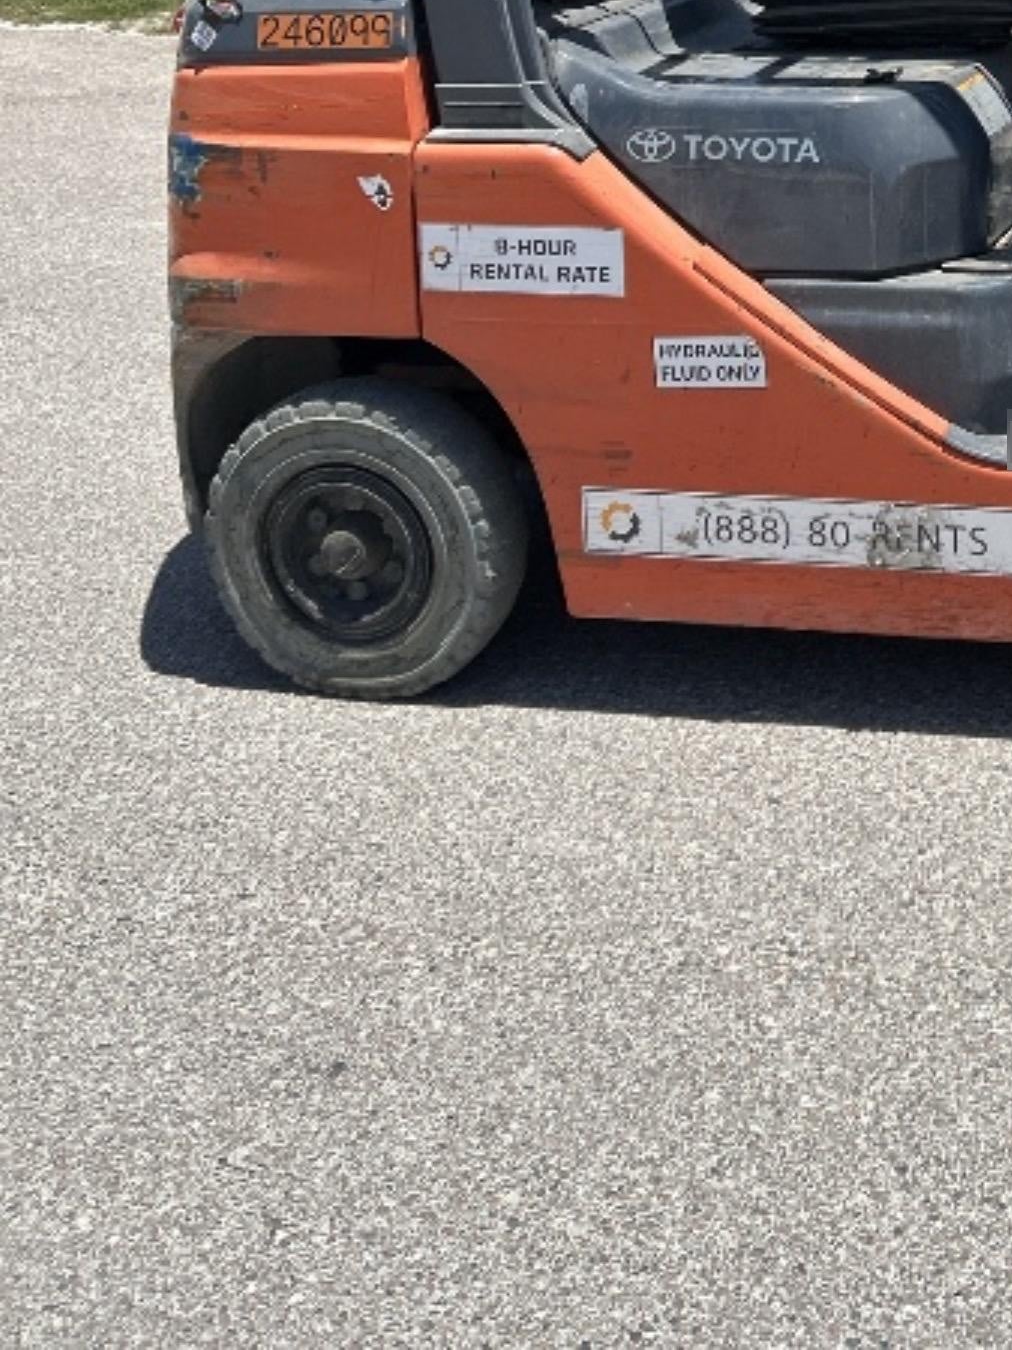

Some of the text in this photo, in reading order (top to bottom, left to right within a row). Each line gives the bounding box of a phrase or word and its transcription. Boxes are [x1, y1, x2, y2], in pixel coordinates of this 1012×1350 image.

[260, 13, 390, 47] 246099
[683, 134, 820, 163] TOYOTA
[494, 239, 577, 256] 8-HOUR
[469, 263, 611, 283] RENTAL RATE
[659, 343, 760, 358] HYDRAULIC
[661, 363, 760, 381] FLUID ONLY
[703, 513, 790, 549] (888)
